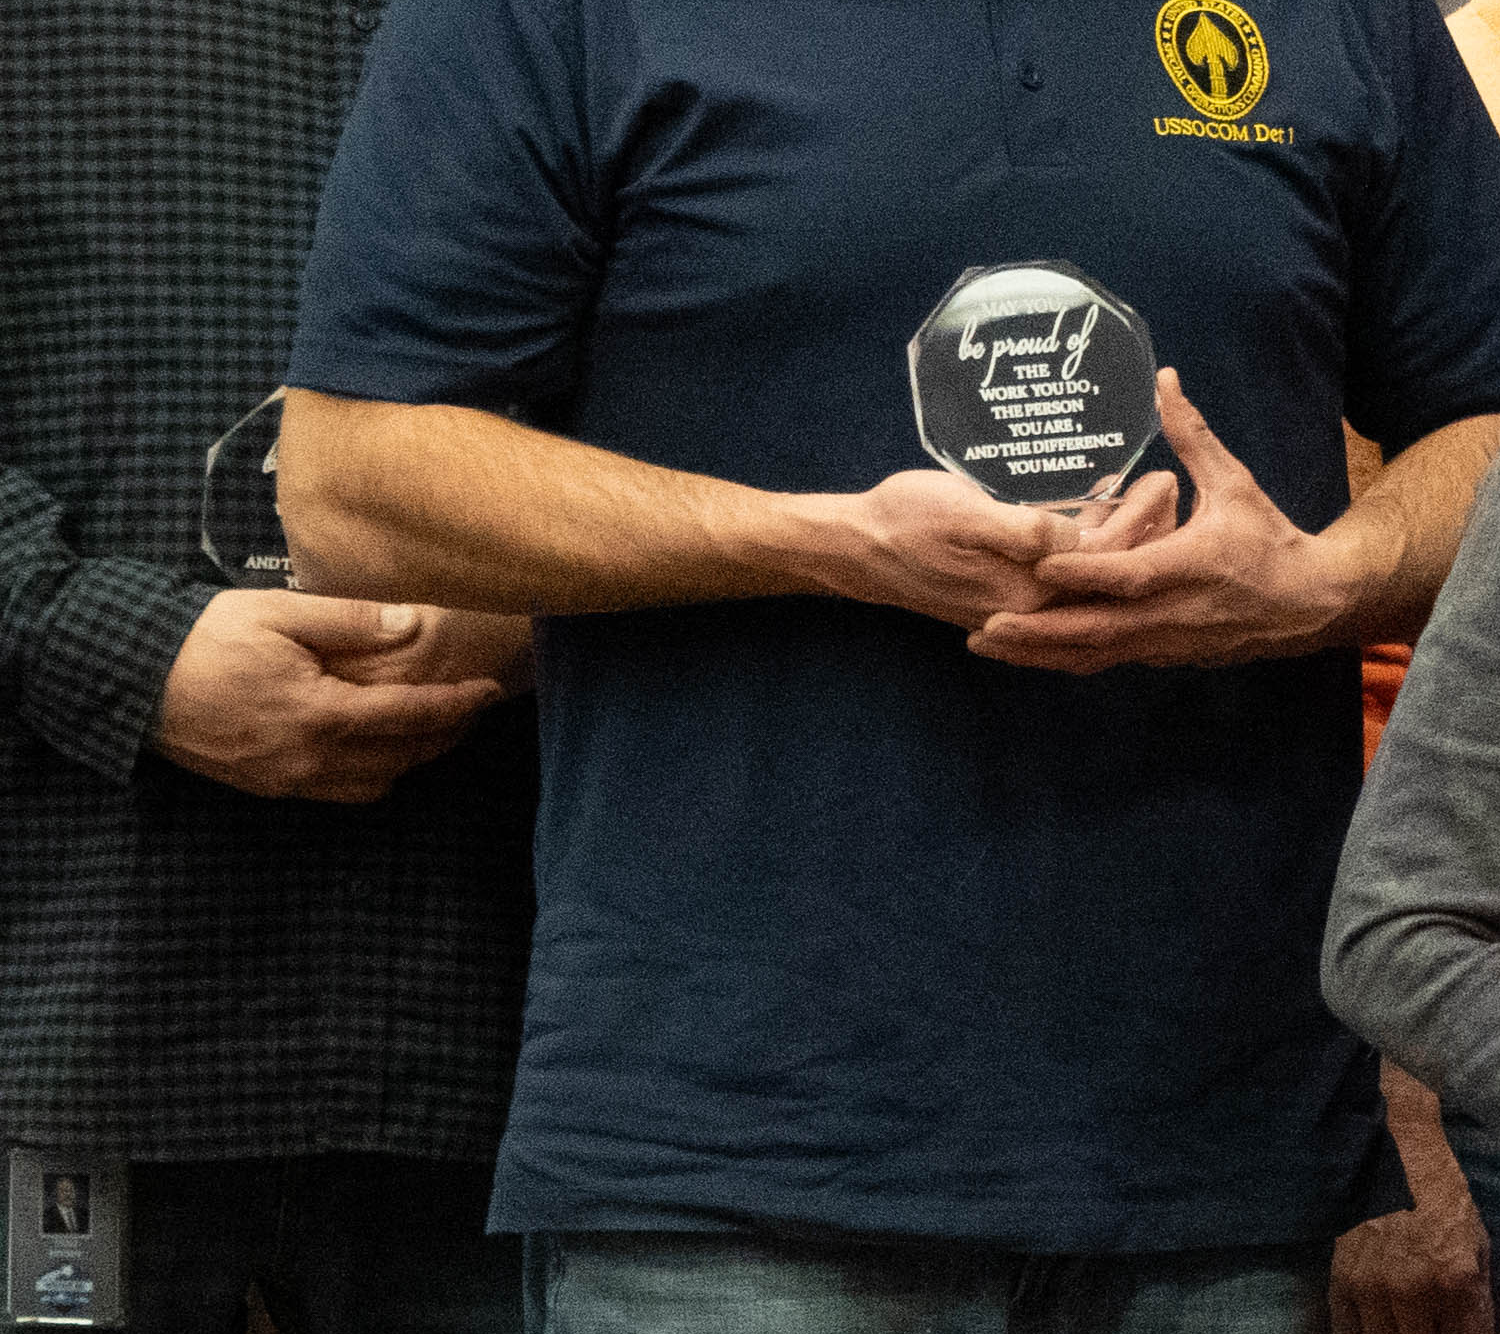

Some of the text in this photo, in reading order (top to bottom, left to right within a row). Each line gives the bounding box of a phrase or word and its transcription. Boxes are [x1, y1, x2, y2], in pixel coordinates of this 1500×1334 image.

[1153, 117, 1250, 142] USSOCOM
[1254, 123, 1285, 145] Det
[958, 304, 1099, 388] be proud of
[1013, 364, 1050, 380] THE
[979, 384, 1029, 401] WORK
[1030, 381, 1066, 397] YOU
[991, 399, 1084, 420] THE PERSON
[1008, 422, 1044, 437] YOU
[965, 433, 1126, 461] AND THE DIFFERENCE
[1006, 460, 1042, 476] YOU
